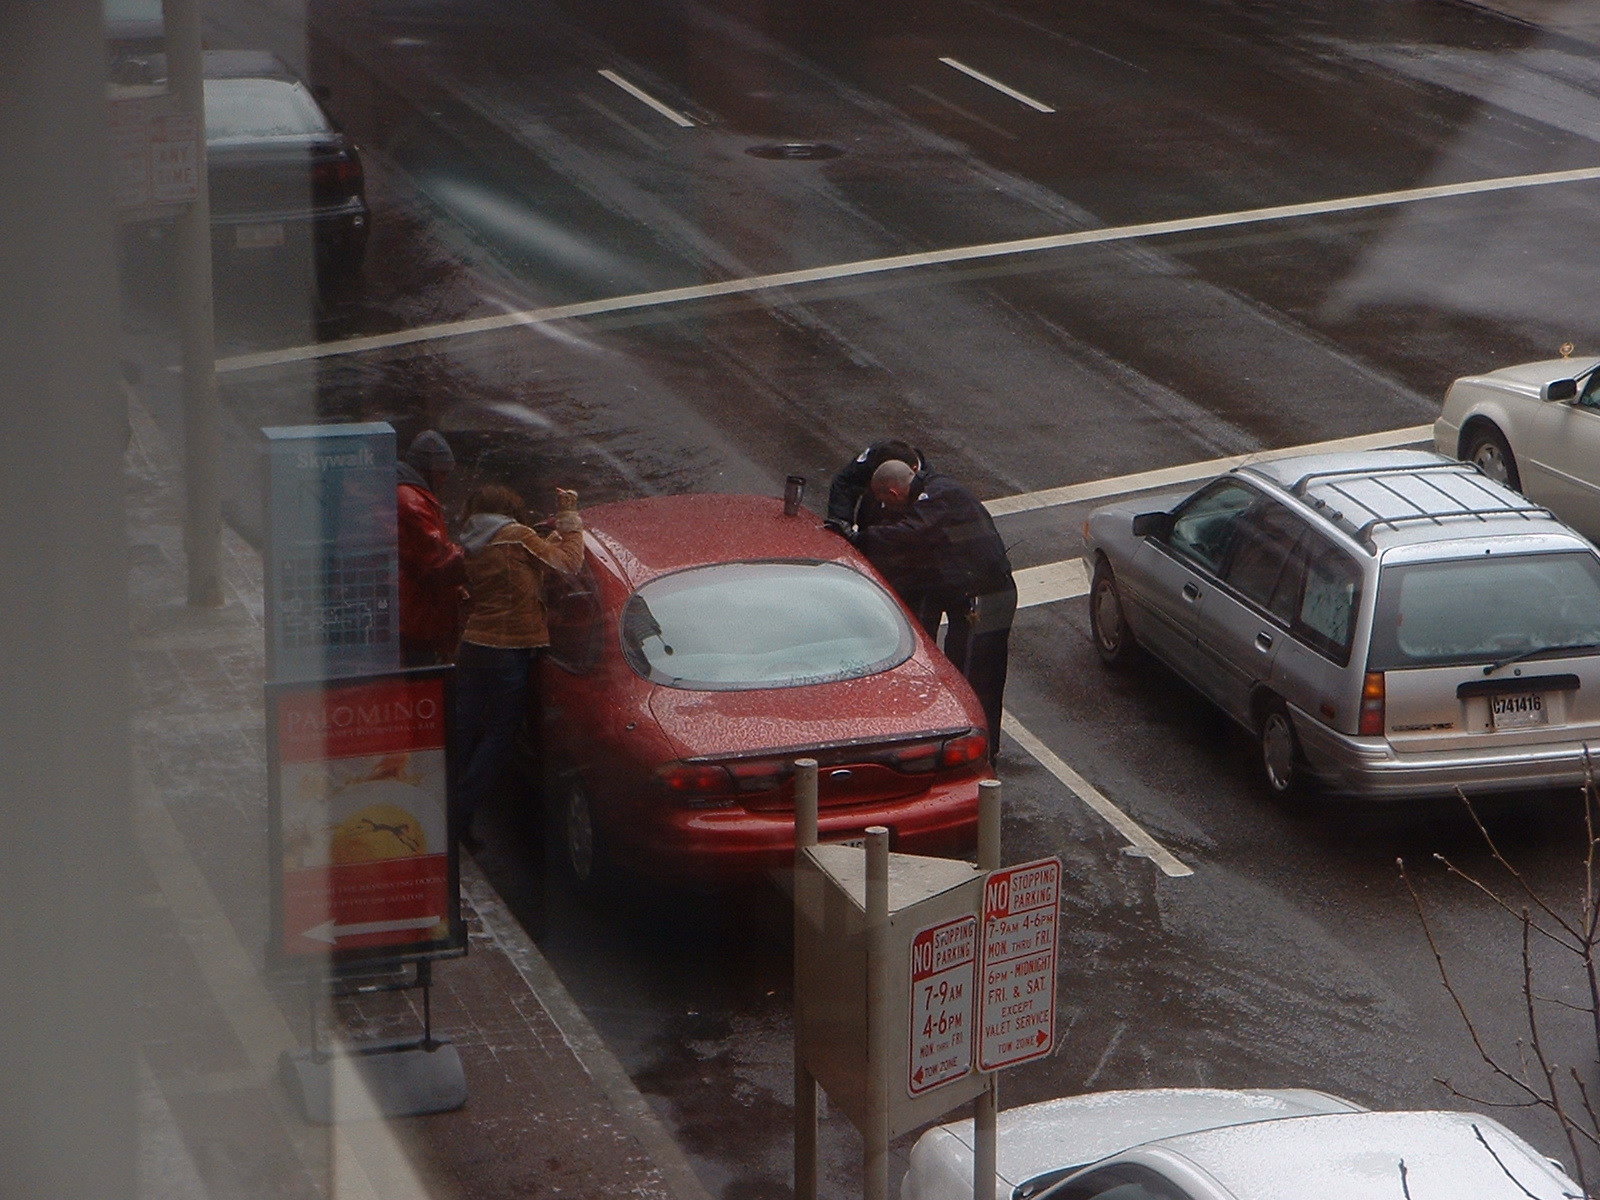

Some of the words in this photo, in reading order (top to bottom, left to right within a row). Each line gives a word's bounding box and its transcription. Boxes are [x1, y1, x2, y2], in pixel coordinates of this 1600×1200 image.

[297, 448, 374, 471] Skywalk
[287, 698, 437, 732] PALOMINO
[1494, 697, 1541, 715] C741416
[1012, 868, 1055, 892] STOPPING
[987, 881, 1009, 914] NO
[1014, 887, 1051, 910] PARKING
[935, 924, 973, 949] STOPPING
[989, 921, 1019, 939] 7-9AM
[1023, 913, 1053, 930] 4-6PM
[936, 942, 970, 968] PARKING
[1012, 939, 1031, 952] THRU
[914, 942, 932, 975] NO
[989, 970, 1008, 985] 6PM
[1015, 955, 1052, 978] MIDNIGHT
[925, 981, 963, 1011] 7-9AM
[989, 987, 1008, 1005] FRI.
[1013, 985, 1020, 998] &
[1002, 1000, 1034, 1017] EXCEPT
[923, 1010, 962, 1039] 4-6PM
[986, 1021, 1011, 1038] VALET
[1016, 1010, 1049, 1030] SERVICE
[999, 1041, 1014, 1054] TOW
[1016, 1035, 1035, 1050] ZONE
[925, 1065, 939, 1078] TOW
[940, 1056, 958, 1071] ZONE
